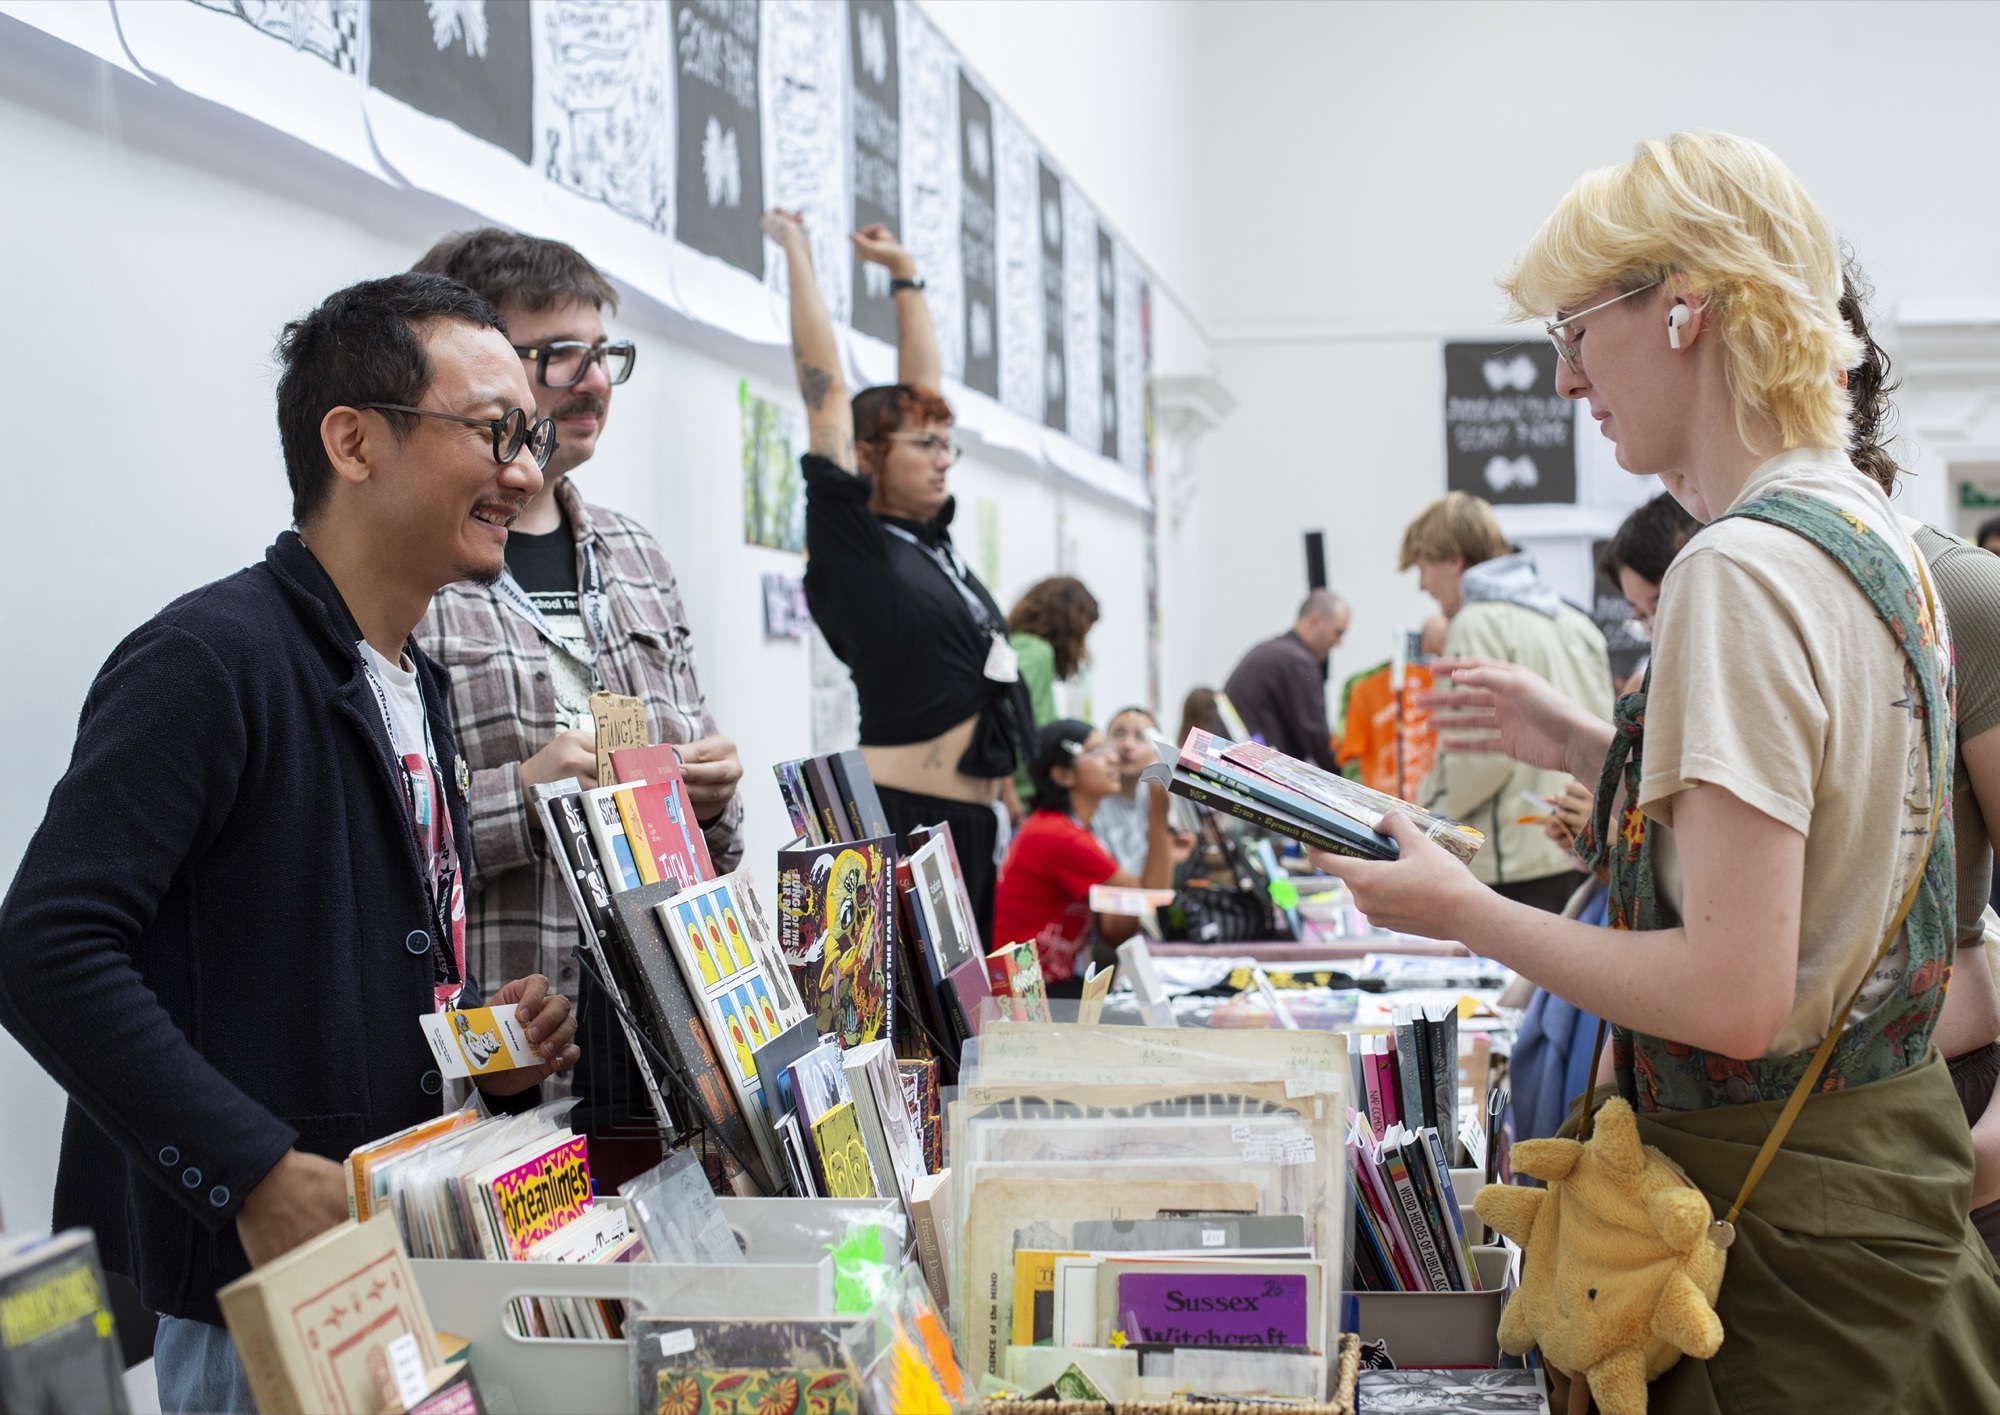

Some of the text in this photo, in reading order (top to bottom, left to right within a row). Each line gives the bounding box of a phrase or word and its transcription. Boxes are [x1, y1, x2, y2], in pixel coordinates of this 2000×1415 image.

[534, 598, 562, 609] chool
[598, 714, 634, 749] FUNGI
[782, 872, 792, 946] FAR REALMS
[792, 930, 800, 947] THE
[886, 972, 892, 988] OF
[1369, 1090, 1384, 1134] NAP COMIX
[1400, 1185, 1418, 1215] WEIRD
[1409, 1211, 1430, 1243] HEROES
[920, 1216, 942, 1300] Friendly Demons
[1420, 1239, 1432, 1251] OF
[1424, 1250, 1443, 1279] PUBLIC
[1165, 1290, 1260, 1313] Sussex
[988, 1272, 998, 1376] CIENCE of the MIND
[1142, 1327, 1288, 1344] Witchcraft
